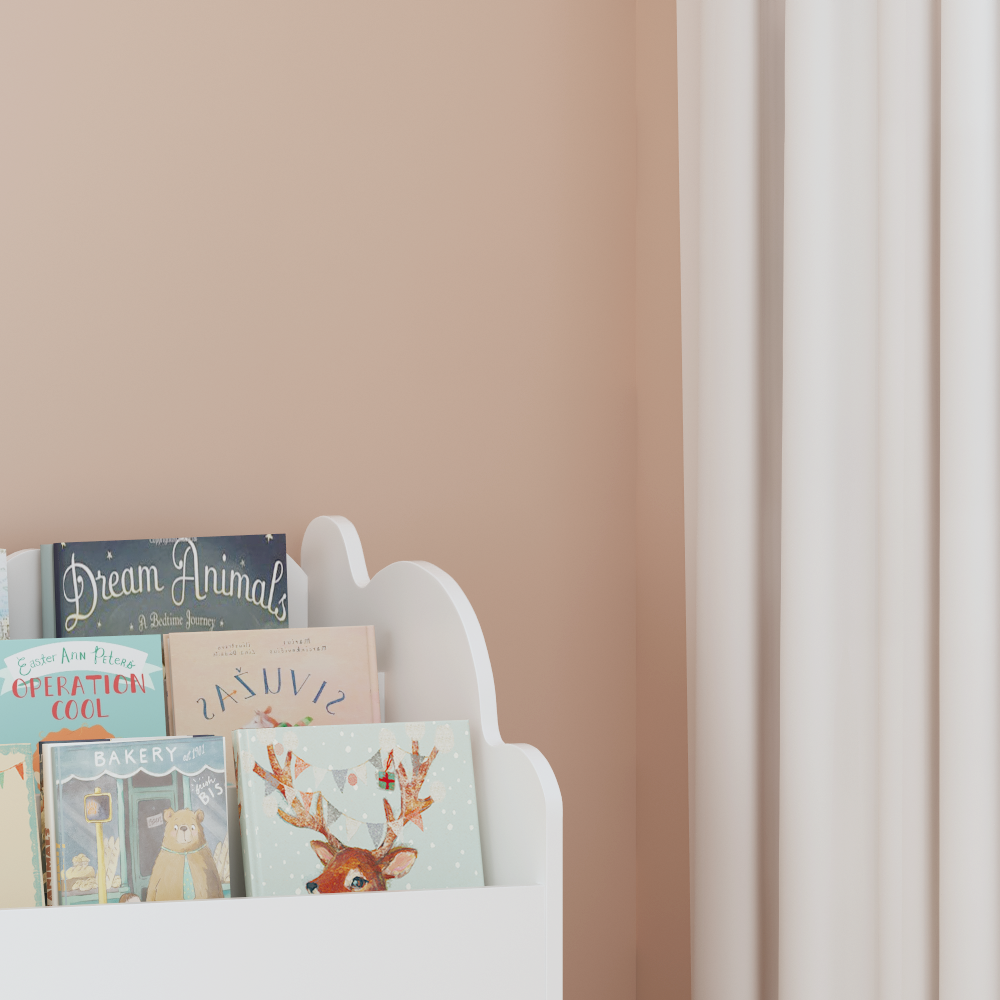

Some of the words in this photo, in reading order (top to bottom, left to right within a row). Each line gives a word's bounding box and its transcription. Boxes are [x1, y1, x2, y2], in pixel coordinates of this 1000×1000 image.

[62, 552, 165, 632] Dream
[171, 537, 287, 622] Animals
[138, 613, 148, 632] A
[149, 611, 184, 628] Bedtime
[185, 609, 216, 632] Journey
[17, 653, 57, 676] Easter
[12, 673, 146, 699] OPERATION
[51, 698, 110, 721] COOL
[94, 746, 177, 767] BAKERY
[198, 782, 224, 806] BIS
